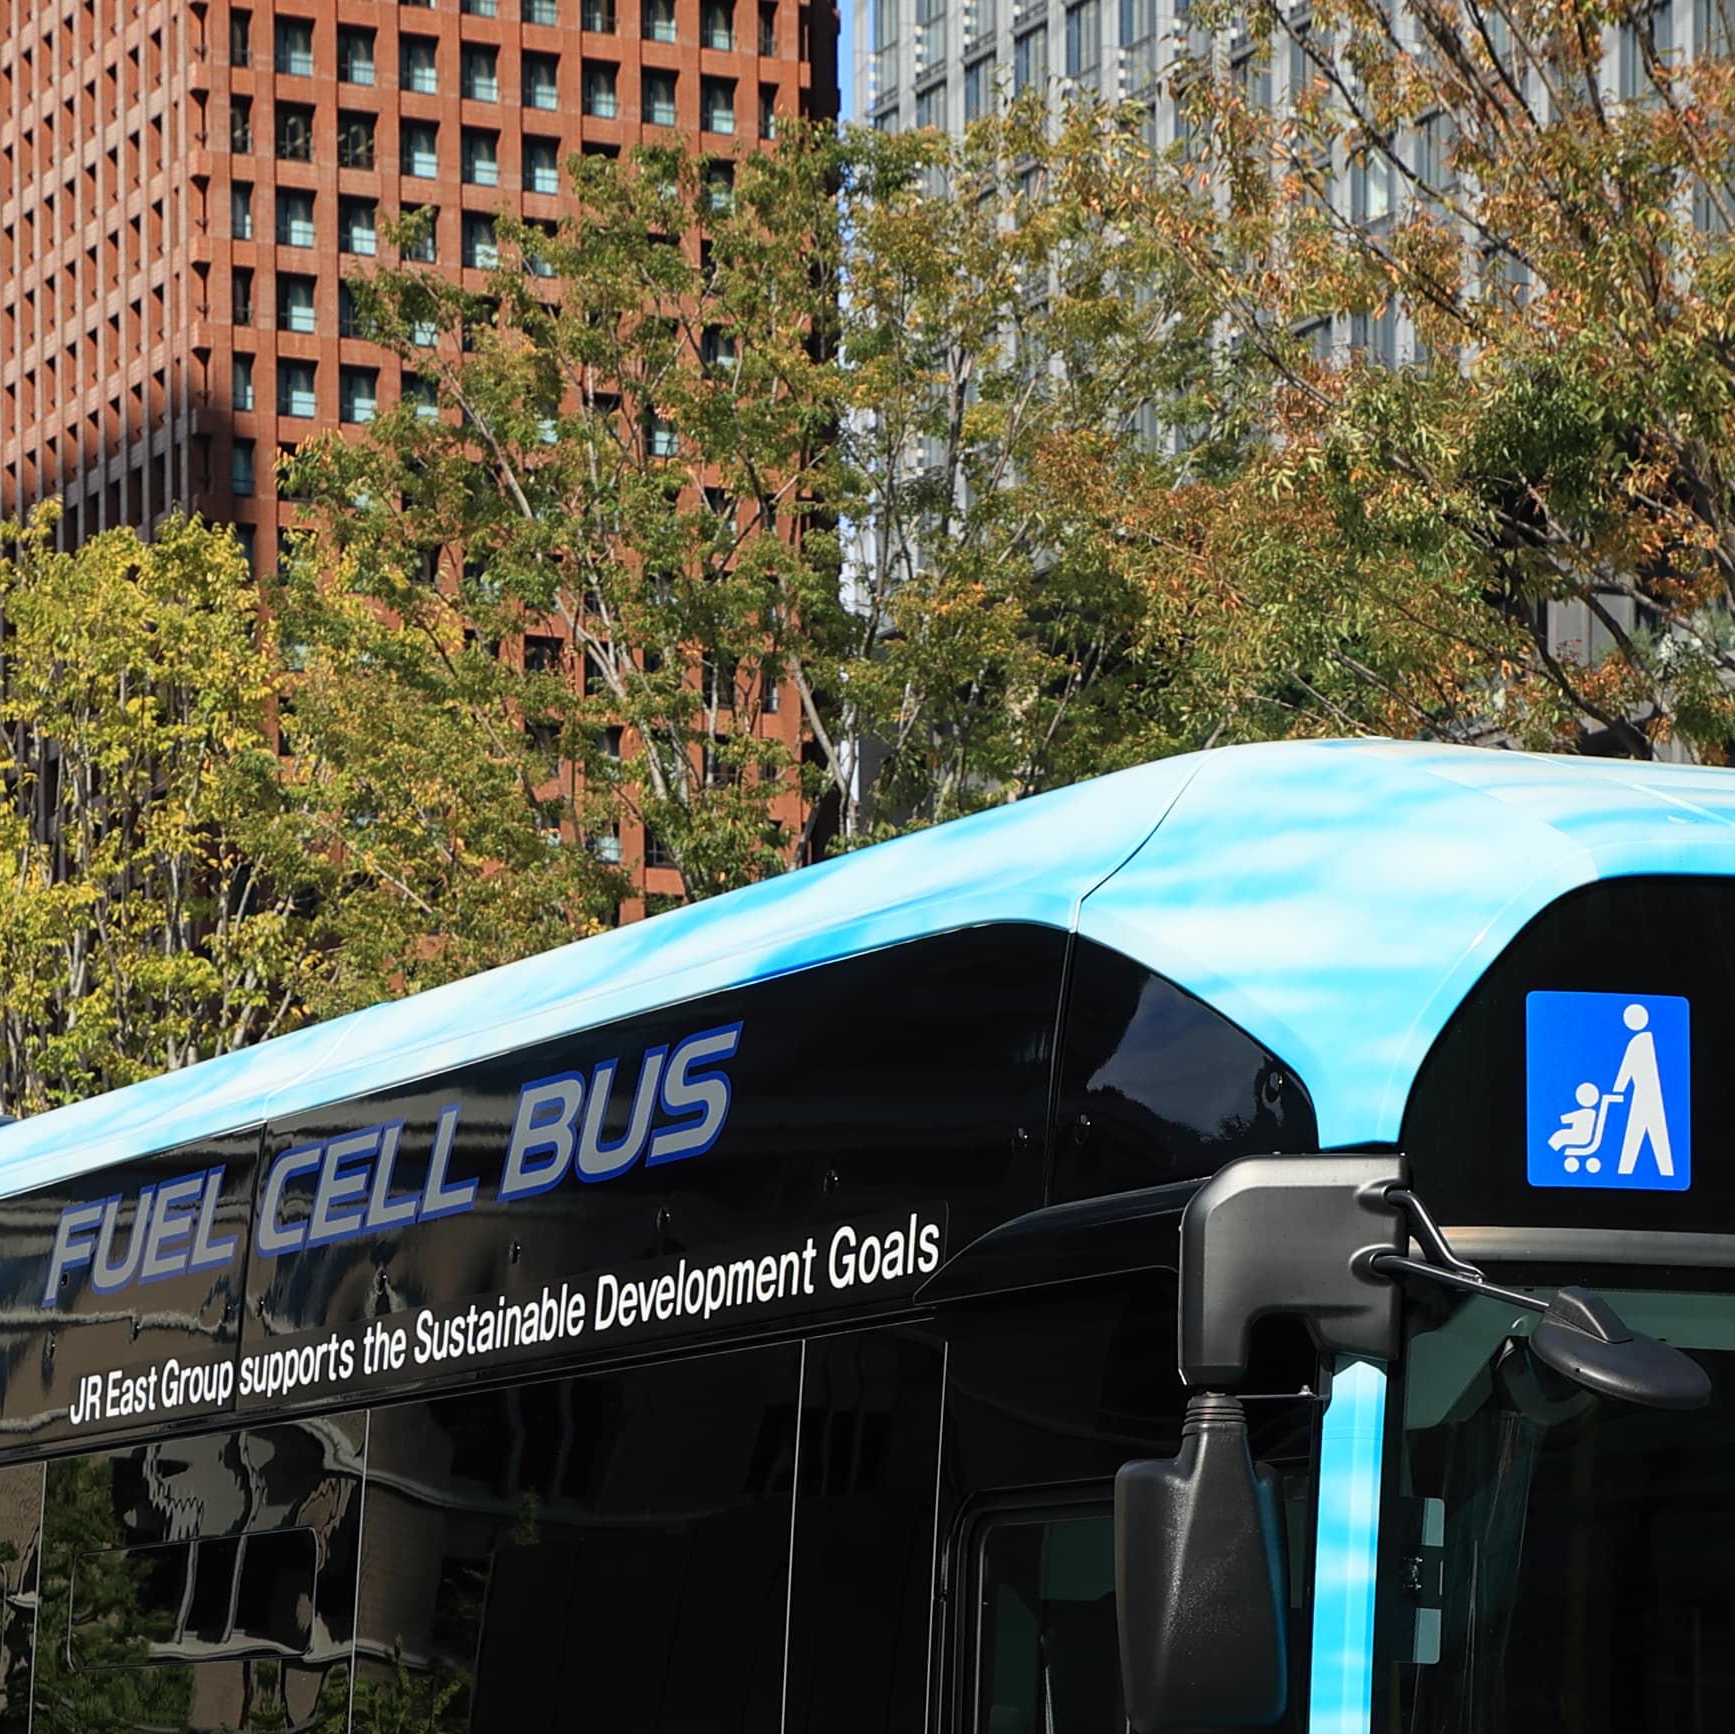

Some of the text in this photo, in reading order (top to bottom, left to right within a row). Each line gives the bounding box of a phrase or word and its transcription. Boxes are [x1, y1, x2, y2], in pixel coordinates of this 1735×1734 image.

[43, 1020, 745, 1307] FUEL CELL BUS
[69, 1213, 941, 1425] JR East Group supports the Sustainable Development Goals
